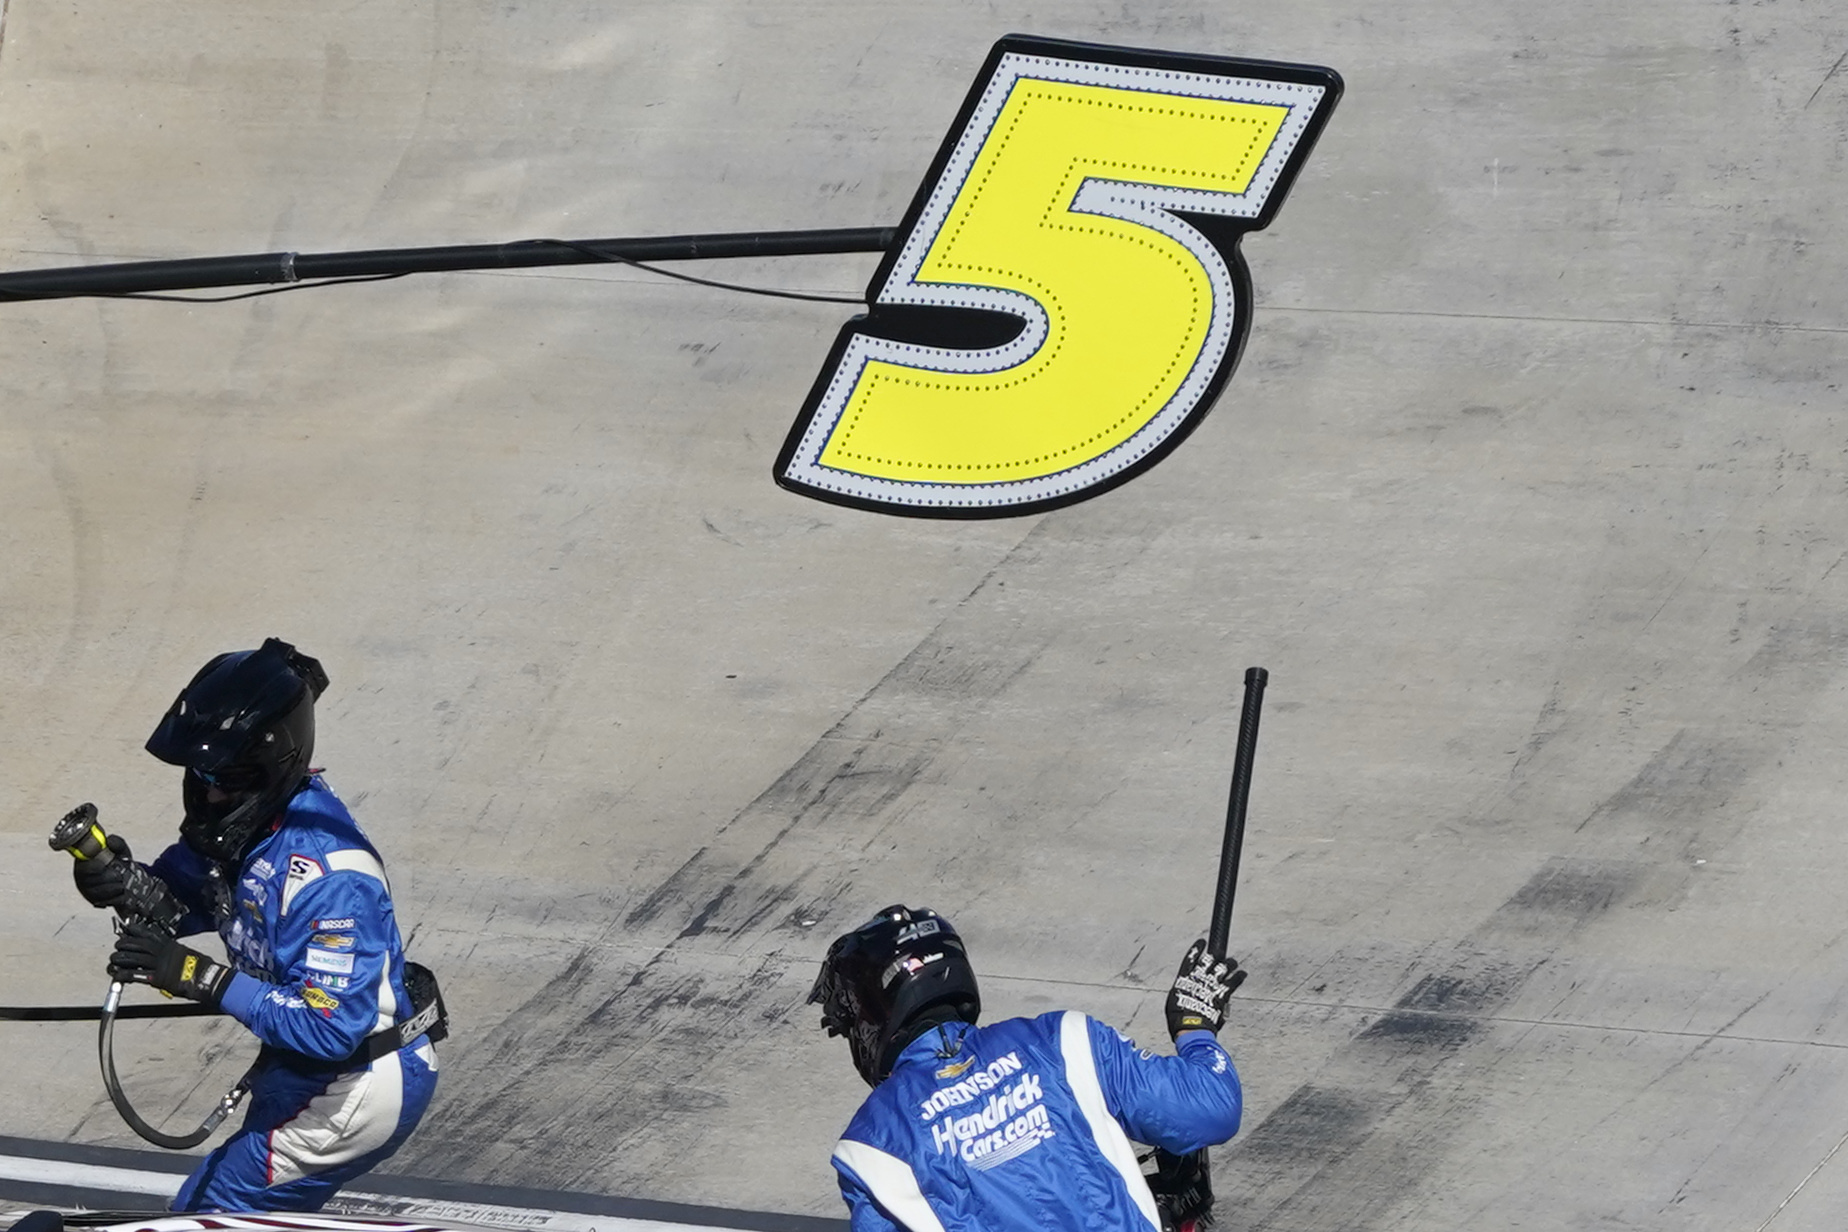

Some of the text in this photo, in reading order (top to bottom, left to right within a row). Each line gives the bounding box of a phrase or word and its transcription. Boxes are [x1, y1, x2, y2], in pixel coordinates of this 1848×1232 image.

[786, 50, 1328, 508] 5
[319, 918, 355, 930] NASCAR
[920, 1052, 1023, 1121] JOHNSON
[932, 1073, 1045, 1157] Hendrick
[961, 1105, 1050, 1163] Cars.com
